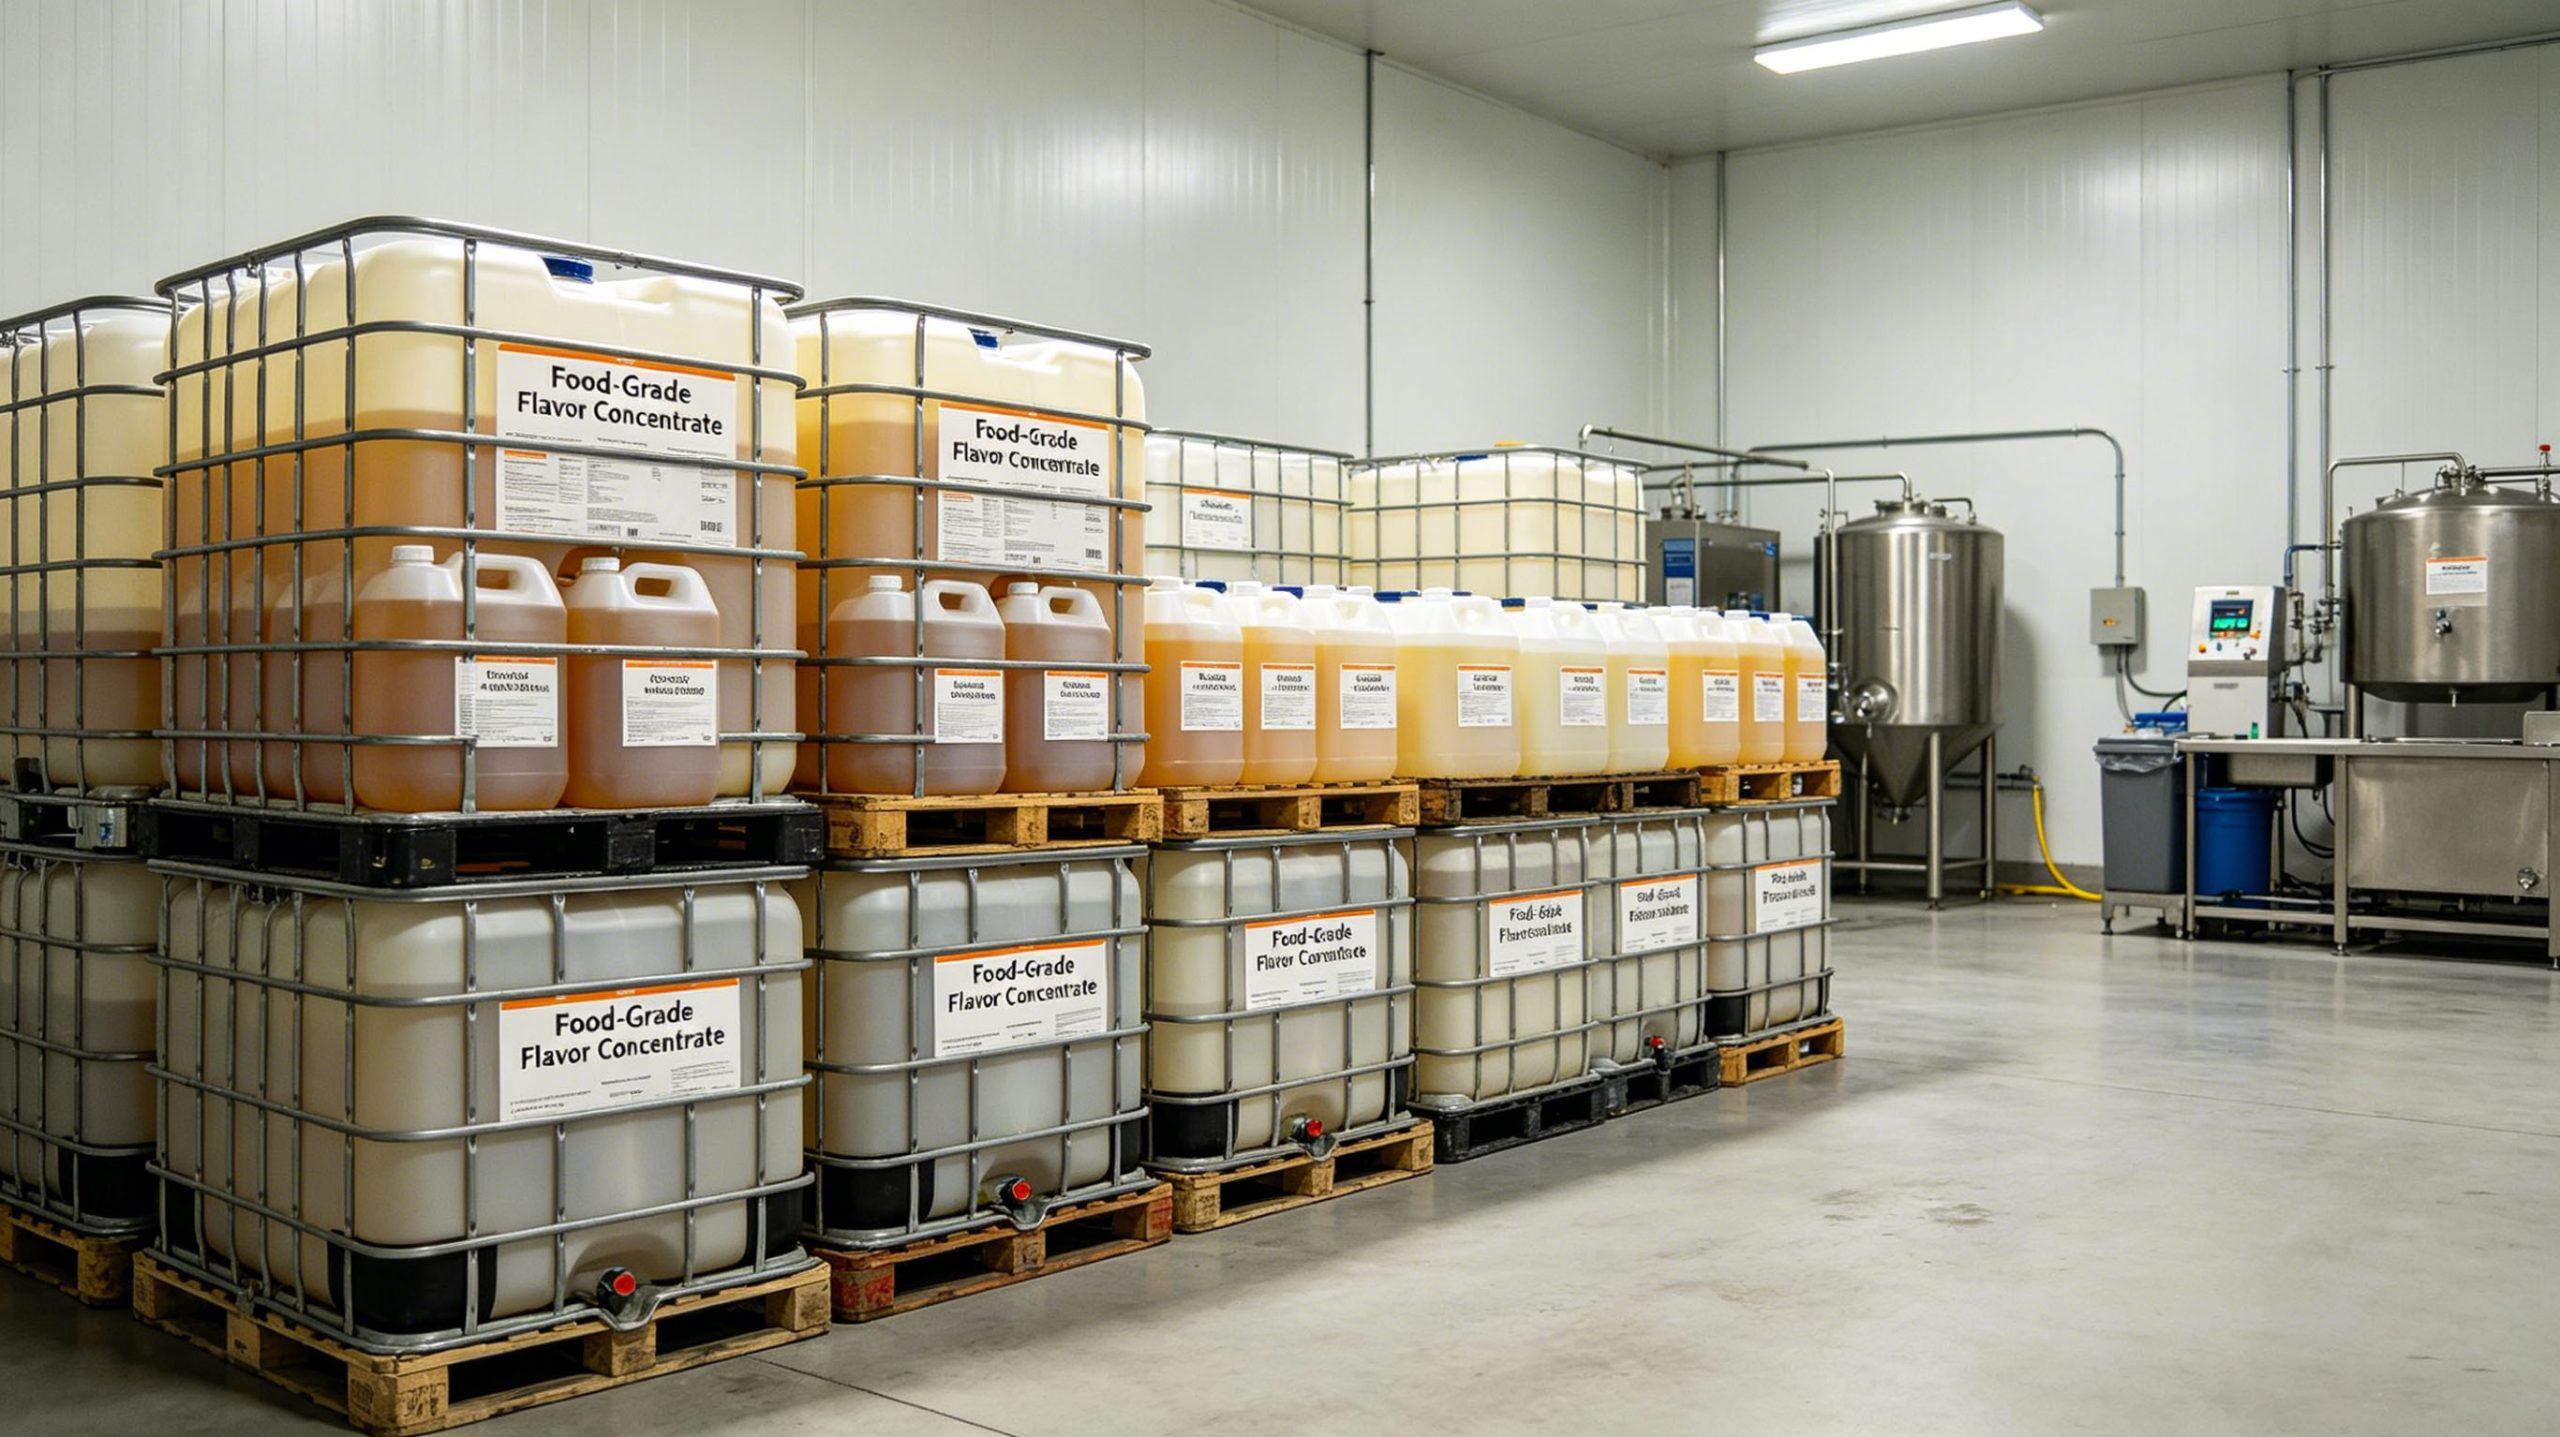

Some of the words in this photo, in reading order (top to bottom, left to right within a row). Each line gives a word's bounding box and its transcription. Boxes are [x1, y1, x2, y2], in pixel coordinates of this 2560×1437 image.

[551, 365, 692, 404] Food-Grade
[517, 391, 588, 420] Flavor
[593, 400, 723, 436] Concentrate
[976, 418, 1078, 450] Food-Grade
[953, 442, 1004, 465] Flavor
[973, 954, 1075, 984] Food-Grade
[948, 991, 1002, 1013] Flavor
[1006, 980, 1098, 1006] Concentrate
[555, 999, 694, 1037] Food-Grade
[521, 1045, 591, 1070] Flavor
[598, 1026, 726, 1060] Concentrate
